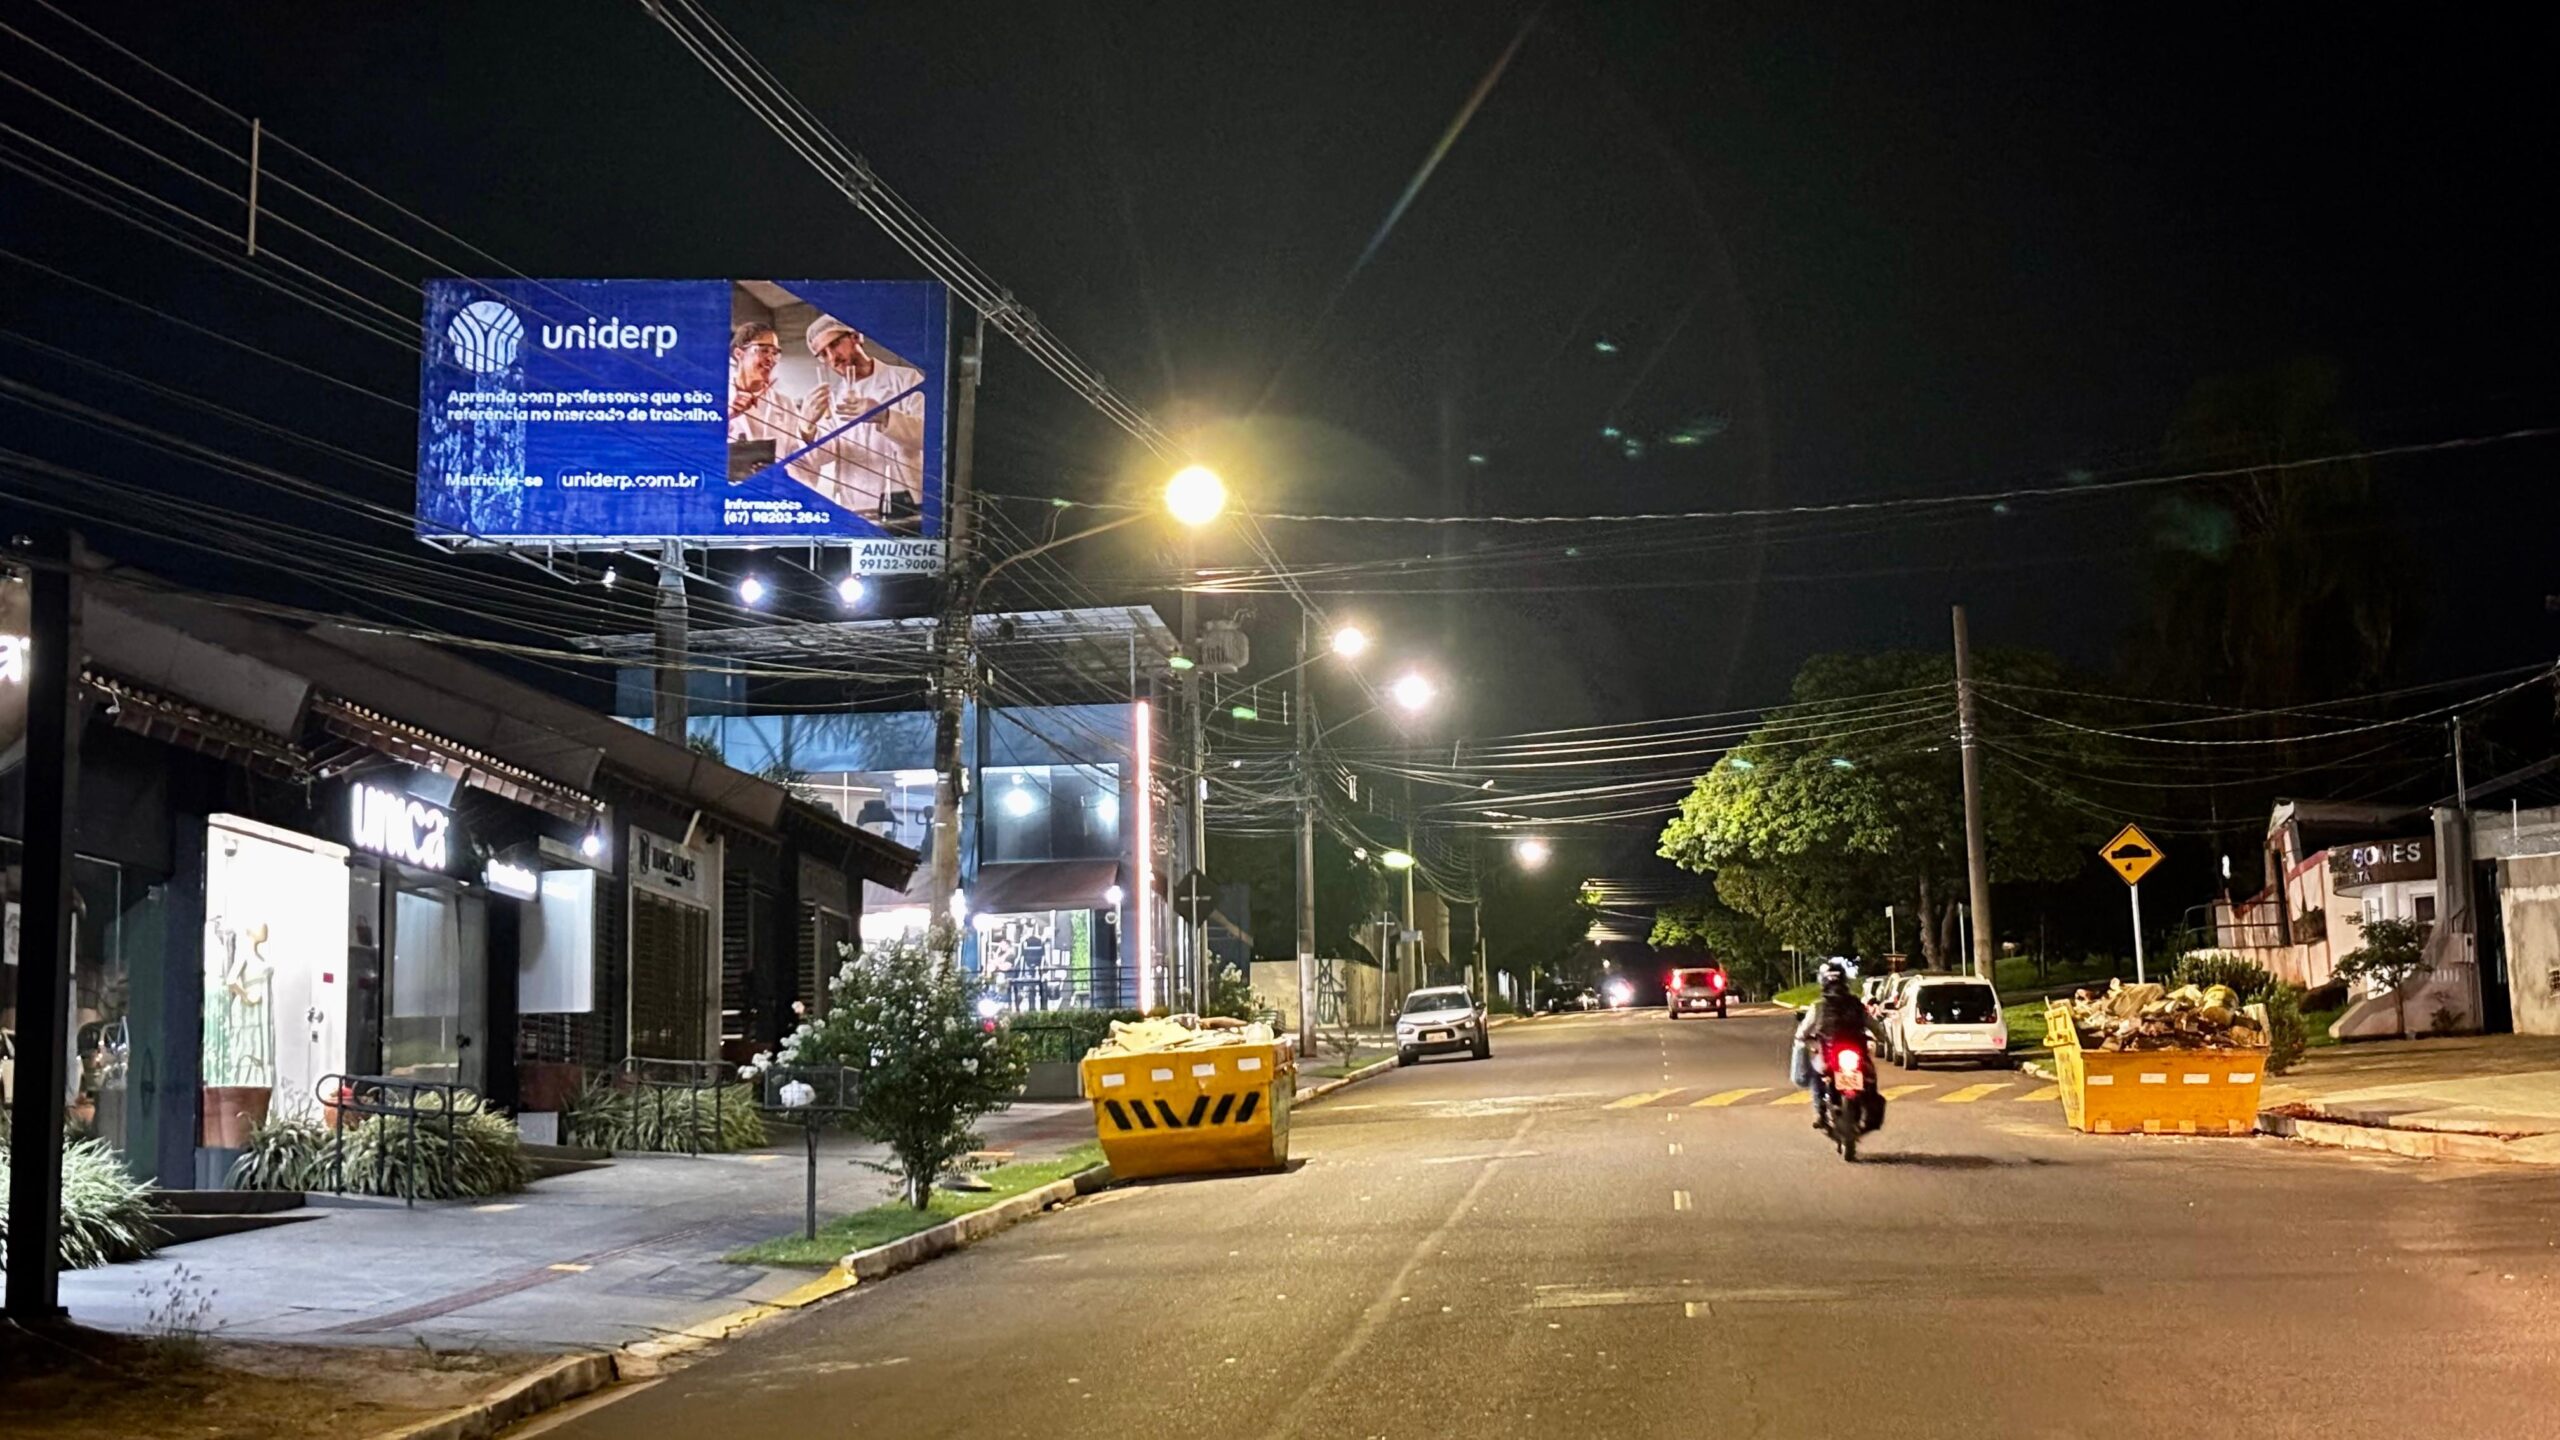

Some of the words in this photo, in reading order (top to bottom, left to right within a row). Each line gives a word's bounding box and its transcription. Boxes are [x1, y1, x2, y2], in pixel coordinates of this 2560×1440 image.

[542, 316, 678, 358] uniderp
[447, 390, 517, 407] Aprenda
[518, 392, 554, 404] com
[556, 389, 649, 407] professores
[650, 392, 682, 407] que
[683, 390, 713, 404] são
[447, 407, 528, 421] referência
[530, 410, 552, 421] no
[553, 407, 625, 421] mercado
[626, 408, 648, 421] de
[649, 408, 723, 422] trabalho.
[561, 471, 699, 491] uniderp.com.br
[724, 510, 749, 526] (67)
[861, 543, 938, 556] ANUNCIE
[859, 559, 937, 570] 99132-9000
[2352, 842, 2421, 868] GOMES
